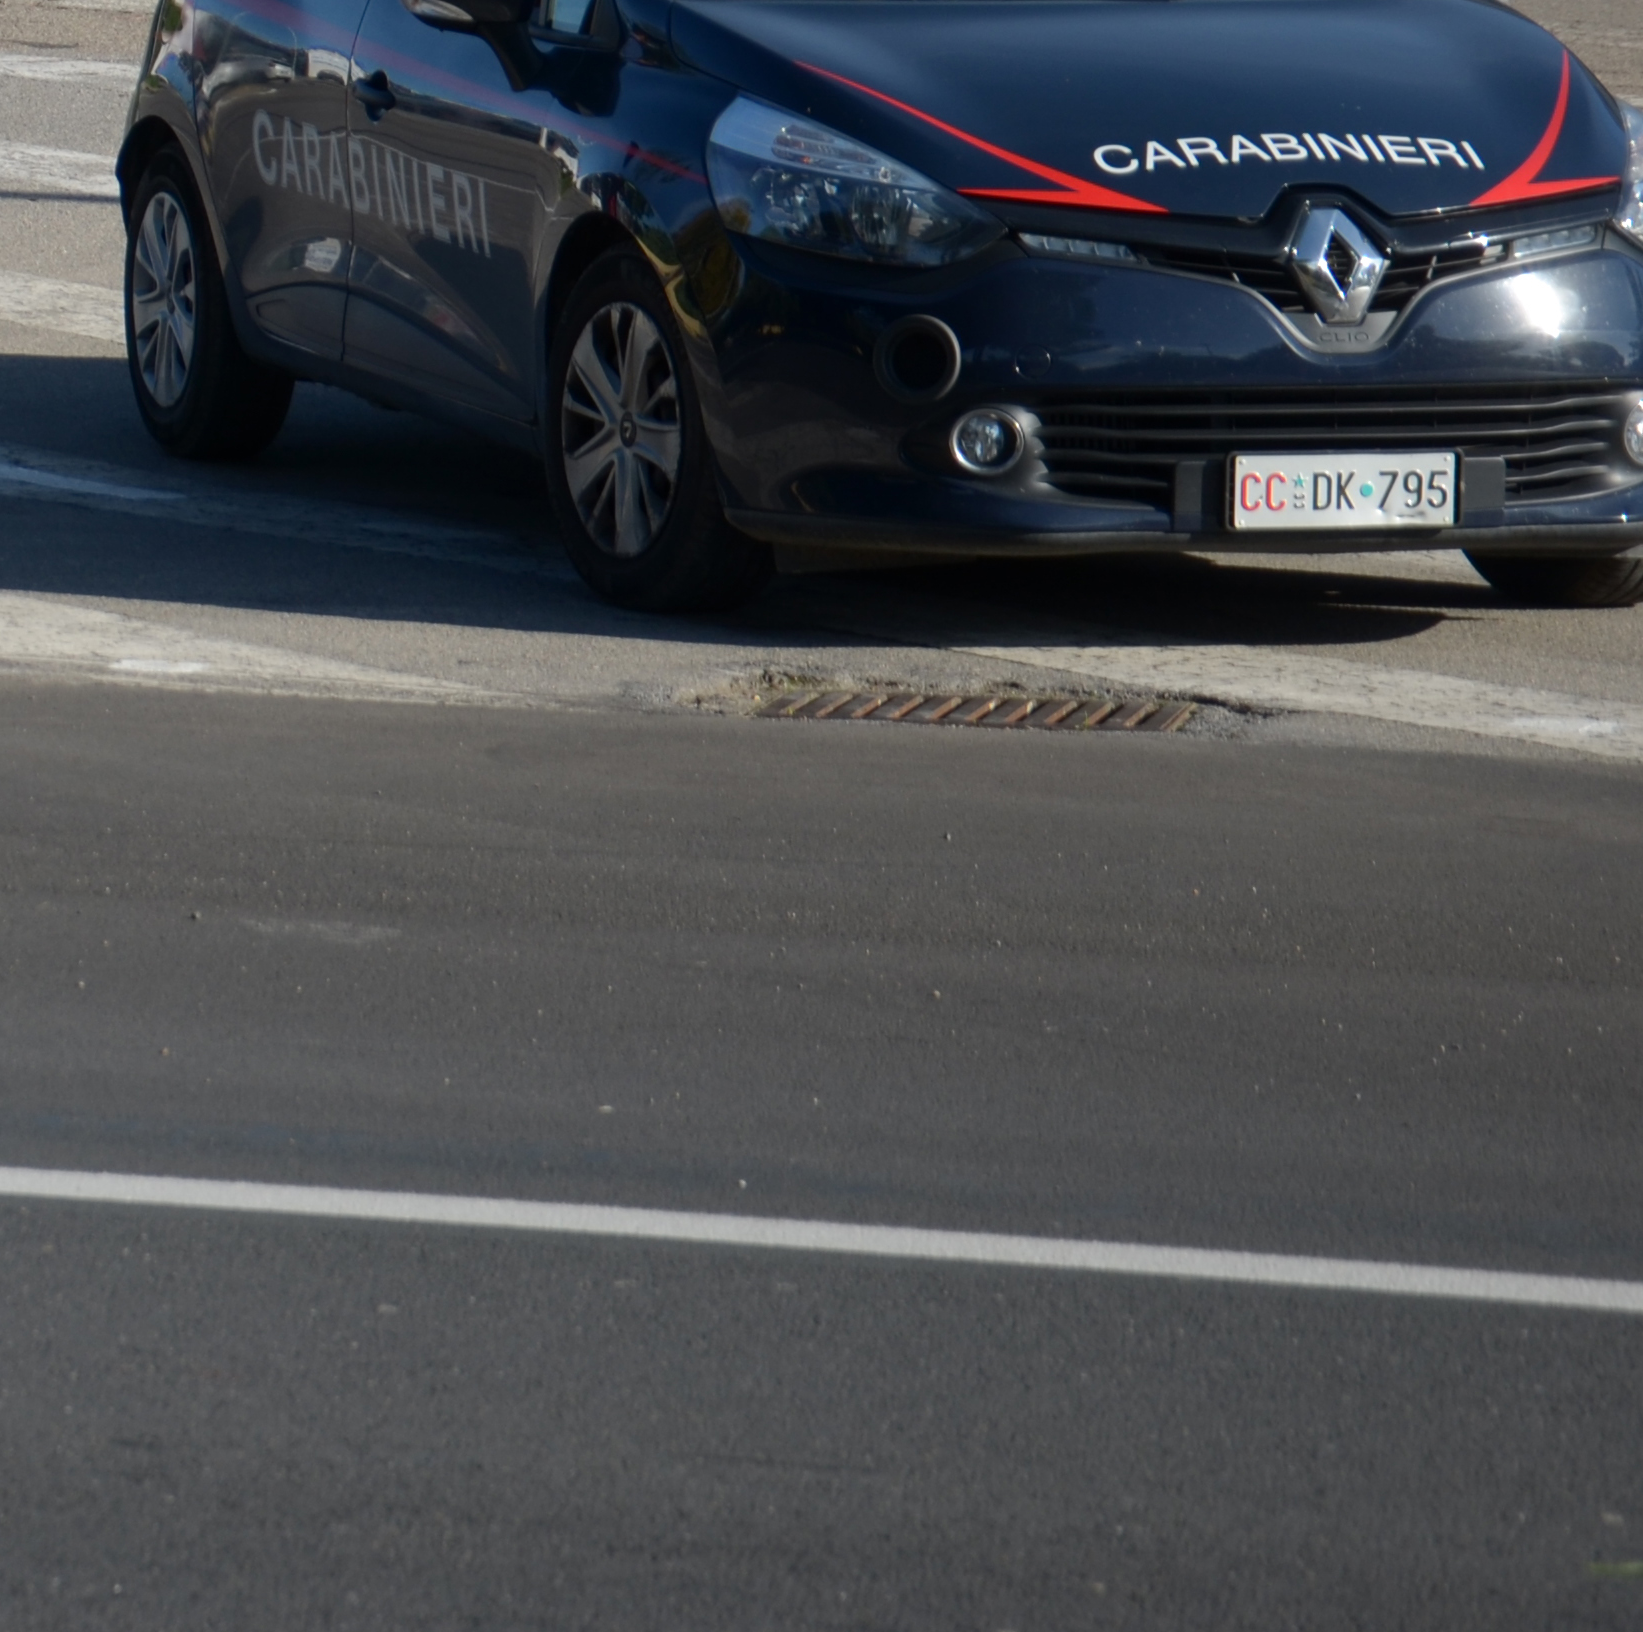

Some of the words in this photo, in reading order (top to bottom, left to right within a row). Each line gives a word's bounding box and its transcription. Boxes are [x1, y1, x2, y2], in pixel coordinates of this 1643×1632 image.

[1093, 133, 1485, 175] CARABINIERI
[252, 109, 491, 258] CARABINIERI
[1319, 332, 1369, 342] CLIO
[1379, 470, 1448, 509] 795
